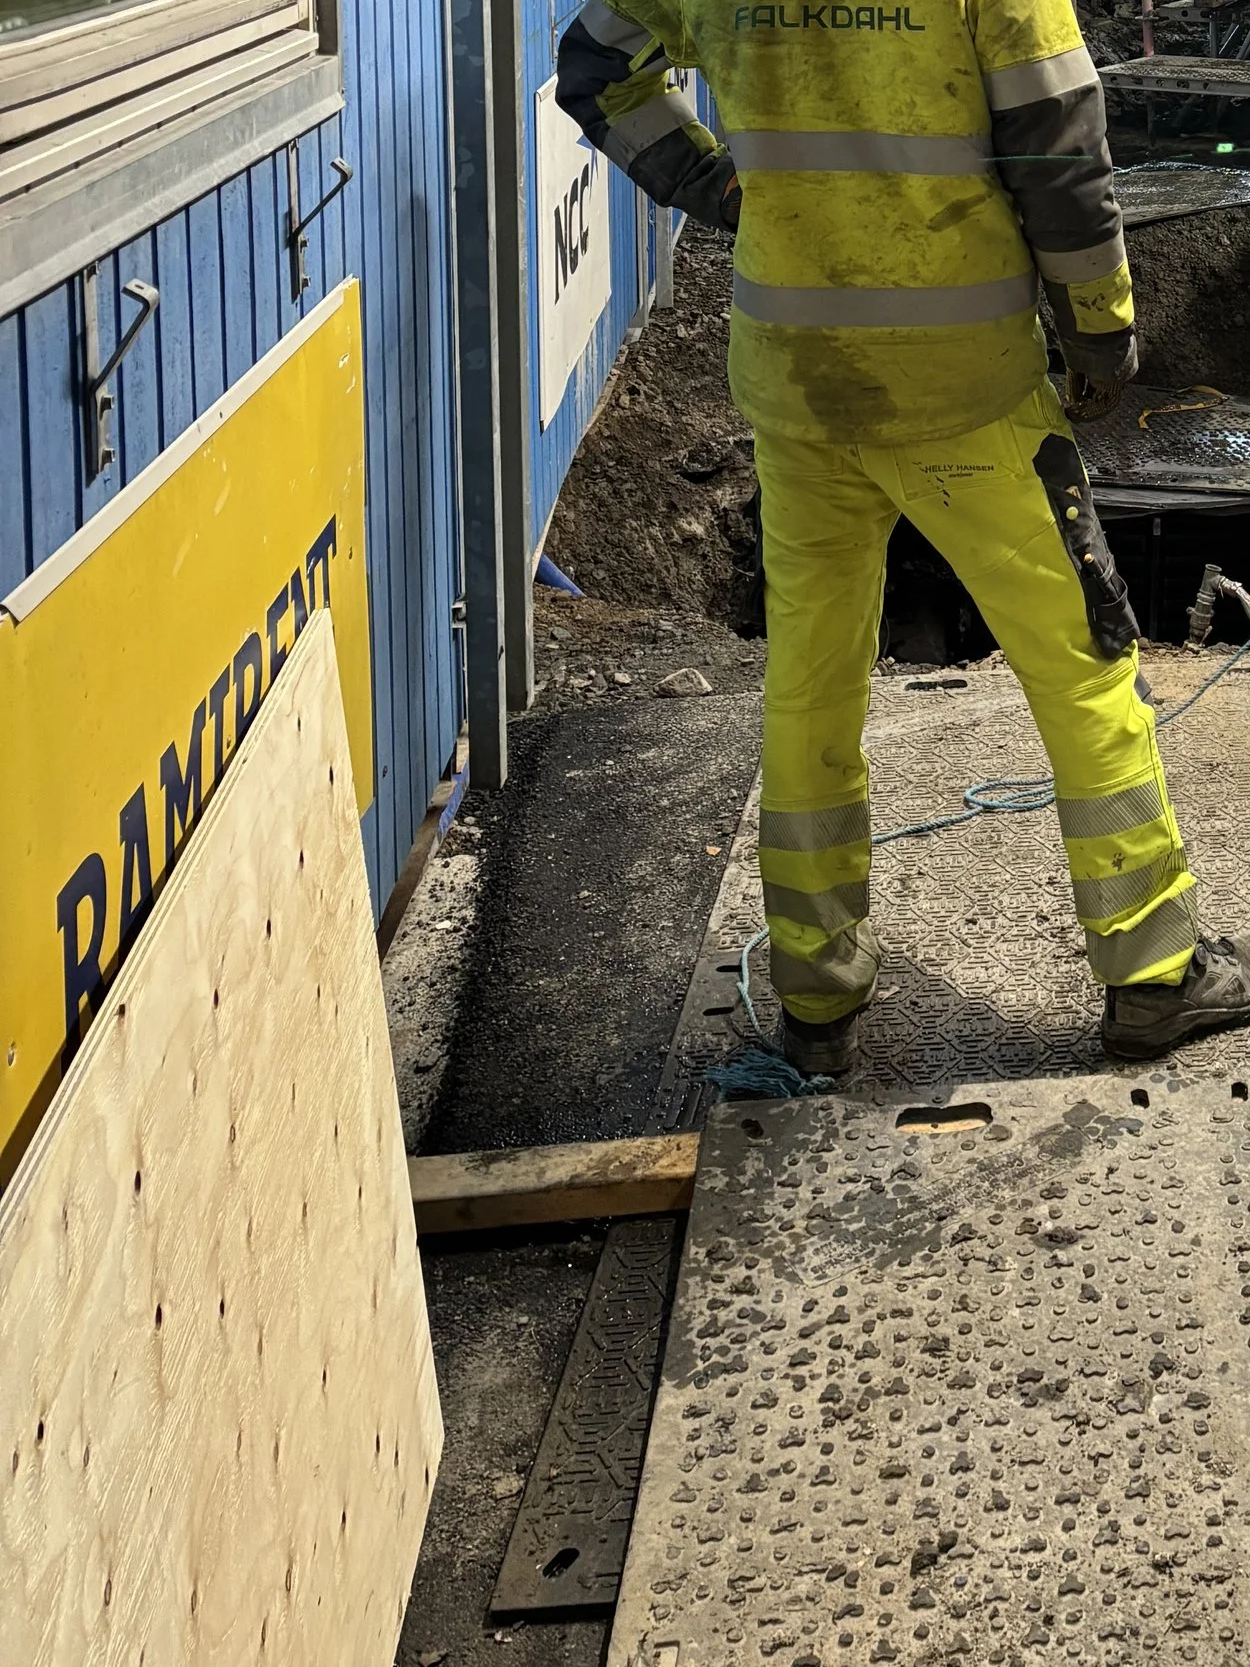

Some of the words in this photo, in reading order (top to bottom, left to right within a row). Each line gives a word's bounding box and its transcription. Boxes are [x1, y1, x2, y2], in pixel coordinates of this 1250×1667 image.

[735, 5, 926, 31] FALKDAHL
[553, 163, 590, 306] NCC
[925, 465, 954, 473] HELLY
[956, 464, 995, 472] HANSEN
